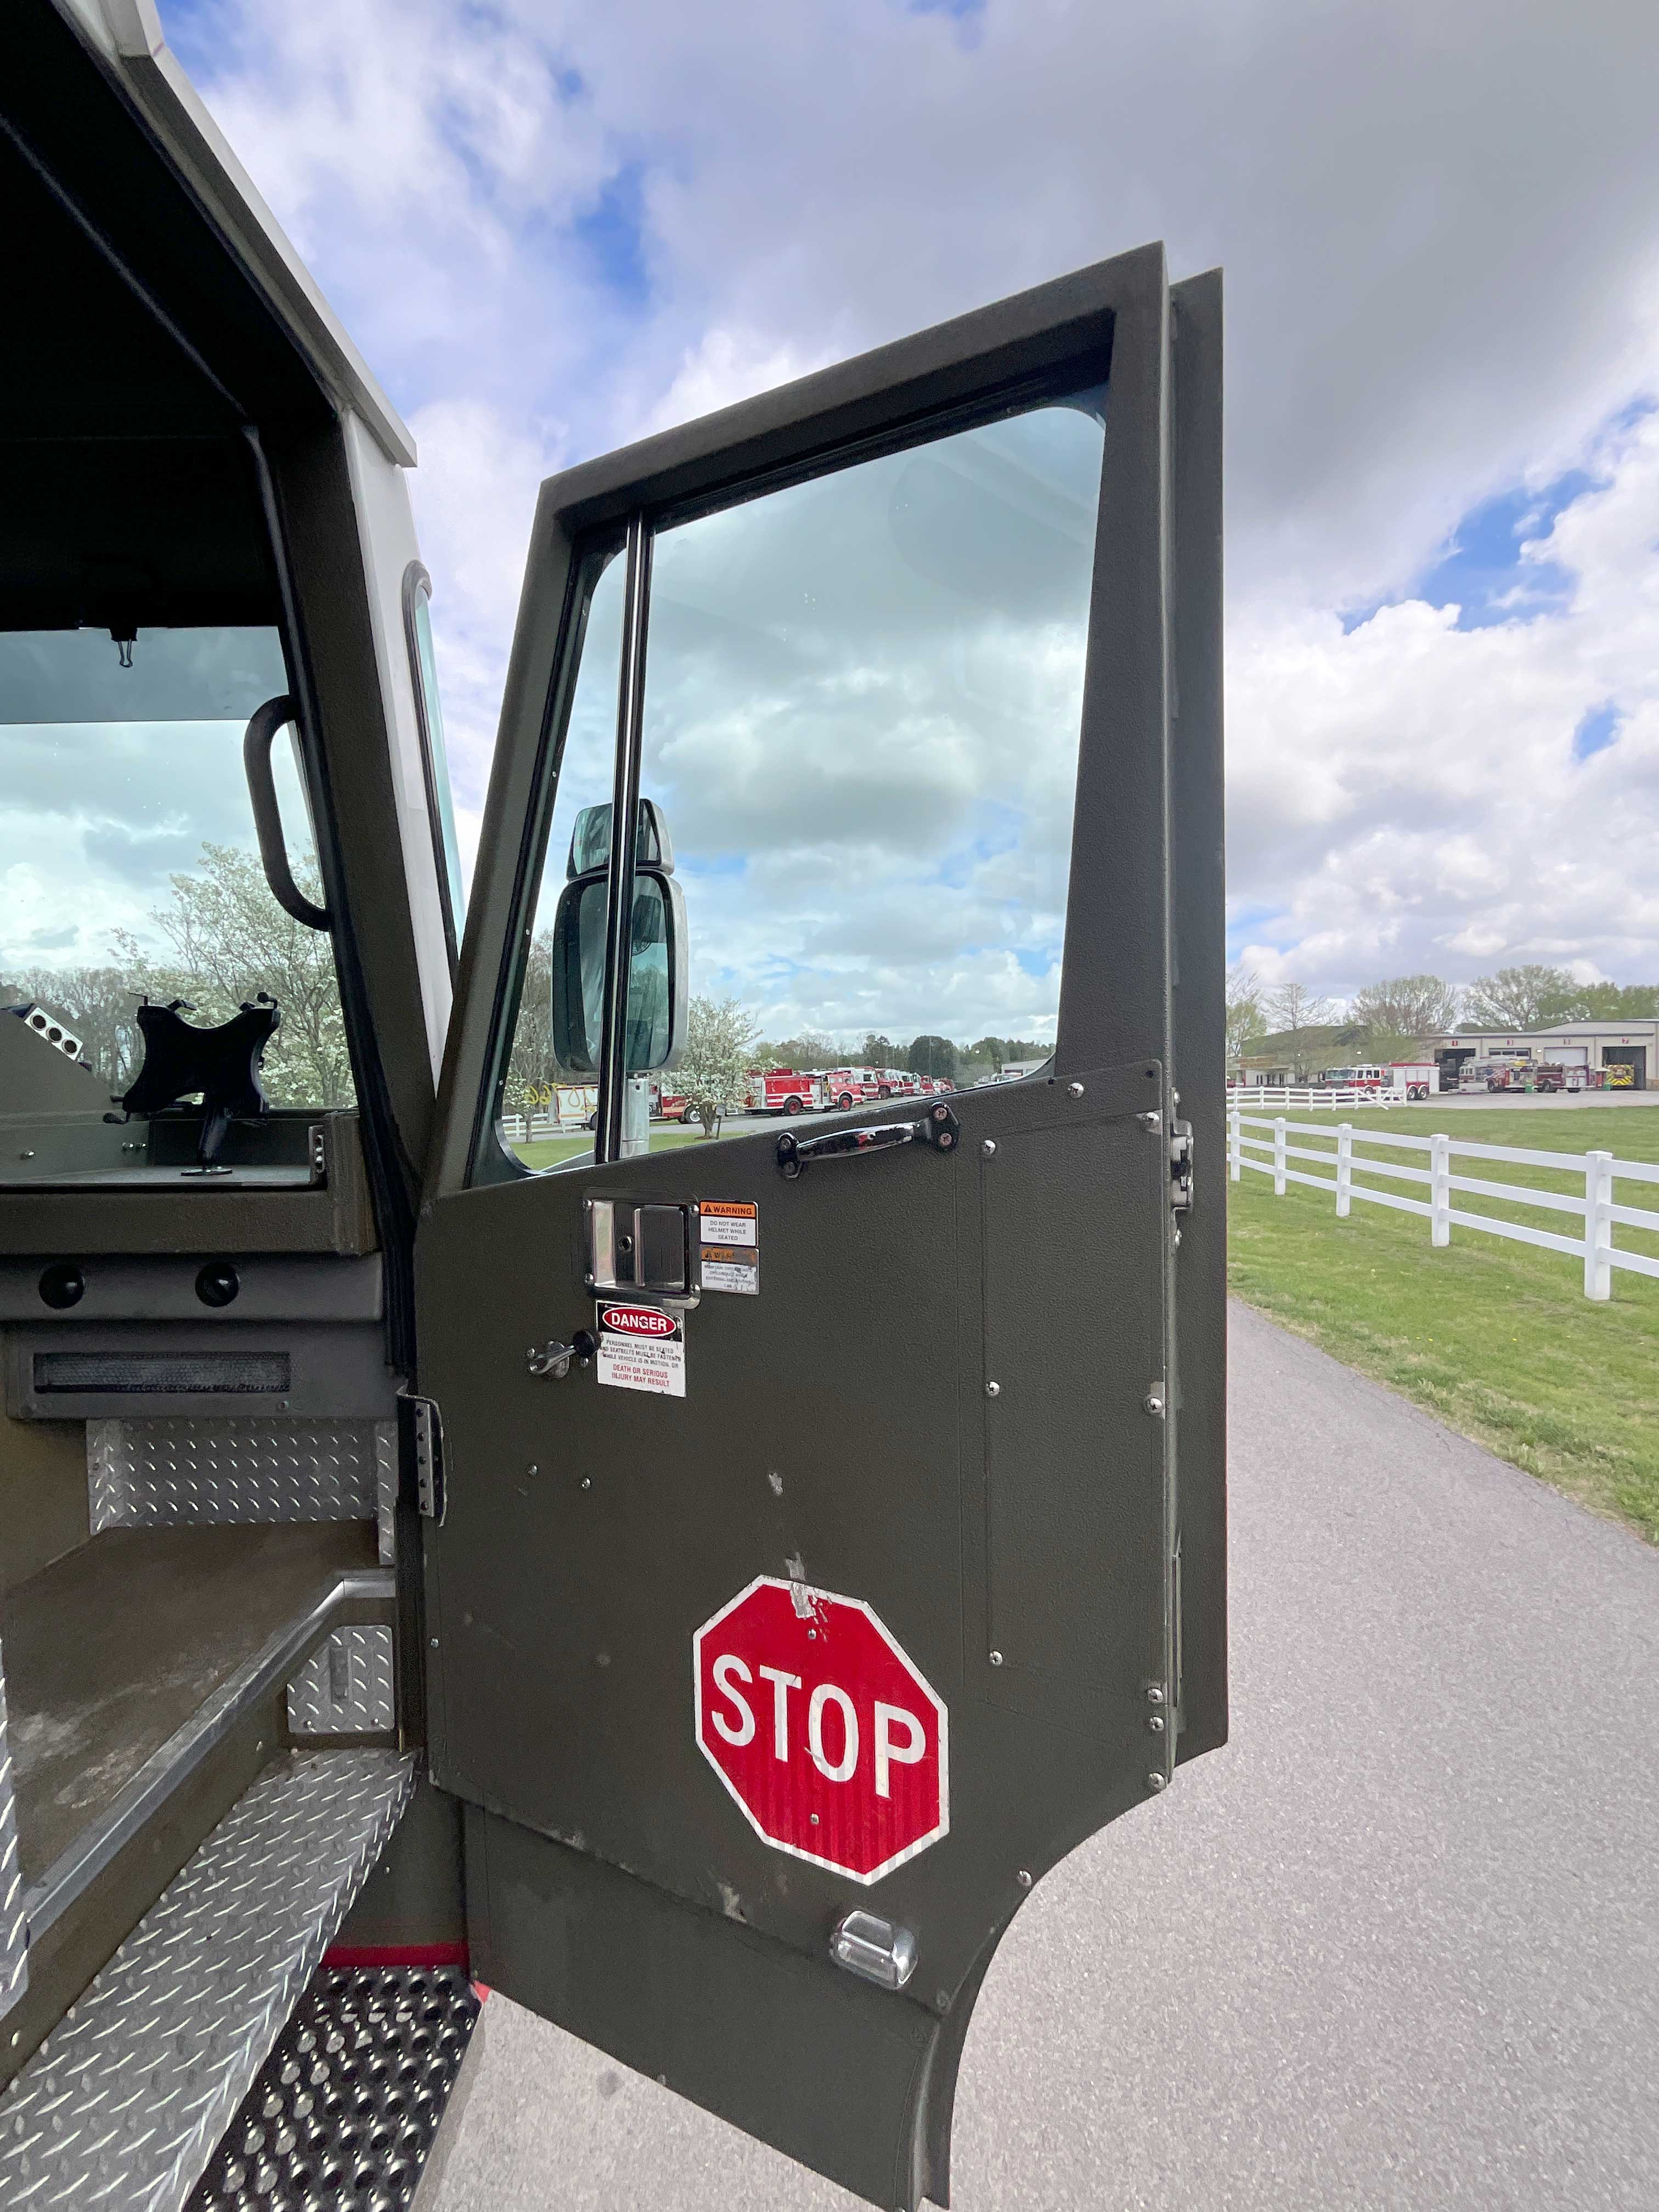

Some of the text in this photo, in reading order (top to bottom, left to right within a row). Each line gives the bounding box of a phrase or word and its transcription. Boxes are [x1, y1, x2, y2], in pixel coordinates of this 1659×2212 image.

[713, 1206, 752, 1215] WARNING
[611, 1313, 667, 1331] DANGER
[606, 1340, 633, 1348] PERSONNEL
[610, 1347, 635, 1356] SEATBELTS
[618, 1355, 637, 1363] VEHICLE
[642, 1368, 668, 1379] SERIOUS
[634, 1375, 646, 1384] MAY
[647, 1378, 669, 1387] RESULT
[711, 1654, 926, 1798] STOP
